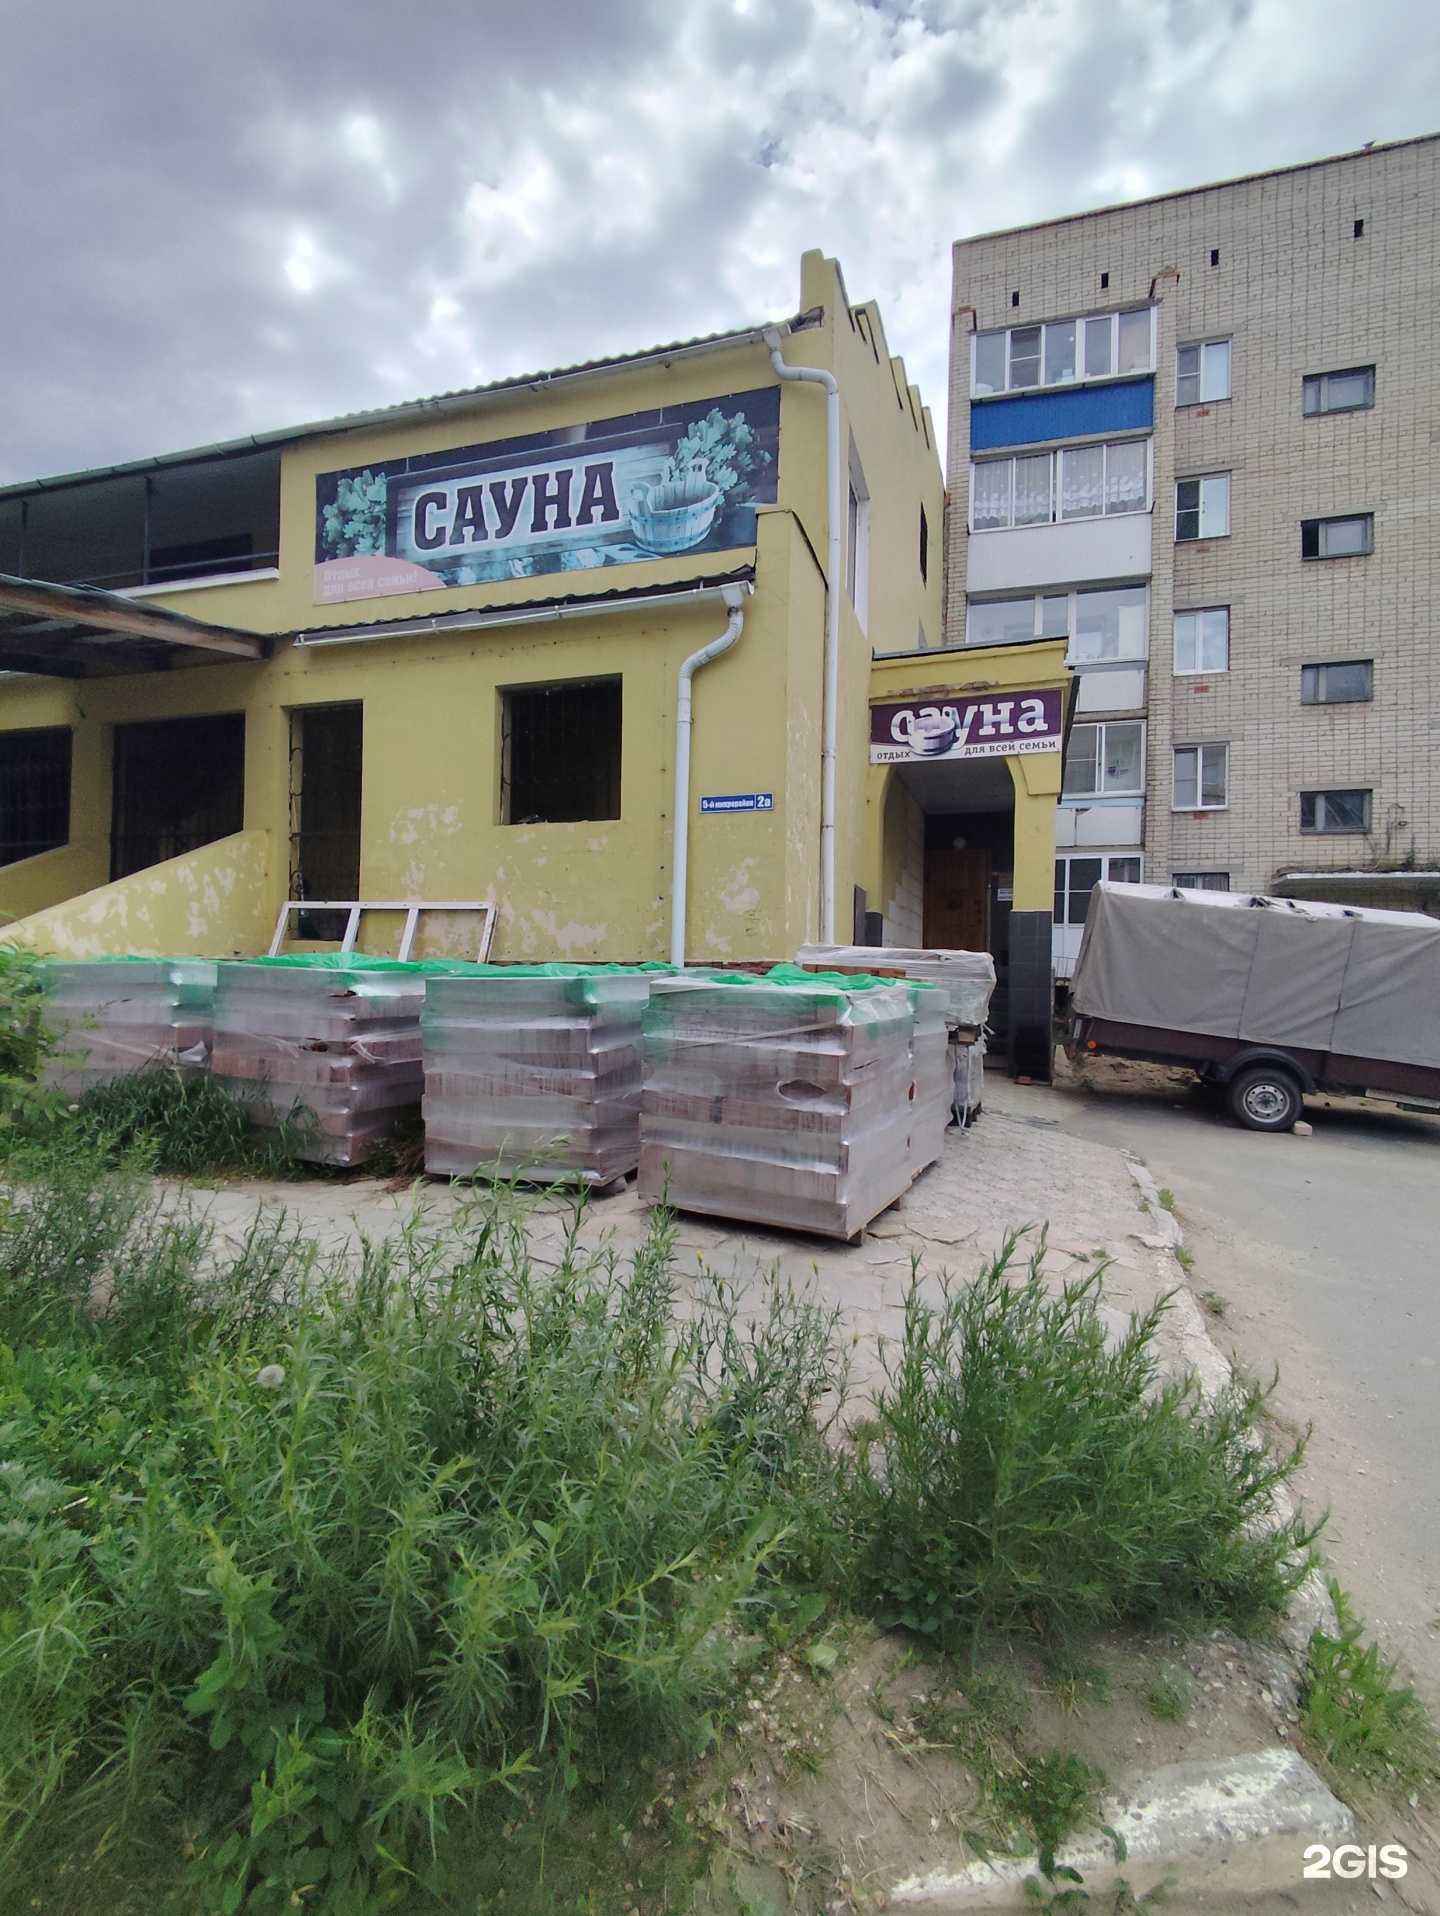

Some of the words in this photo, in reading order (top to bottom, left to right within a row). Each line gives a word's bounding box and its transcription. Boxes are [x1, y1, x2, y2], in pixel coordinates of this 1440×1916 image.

[415, 462, 620, 551] САУНА
[876, 750, 911, 761] отдых
[964, 745, 985, 756] для
[989, 742, 1015, 752] всей
[1019, 740, 1056, 751] семьи
